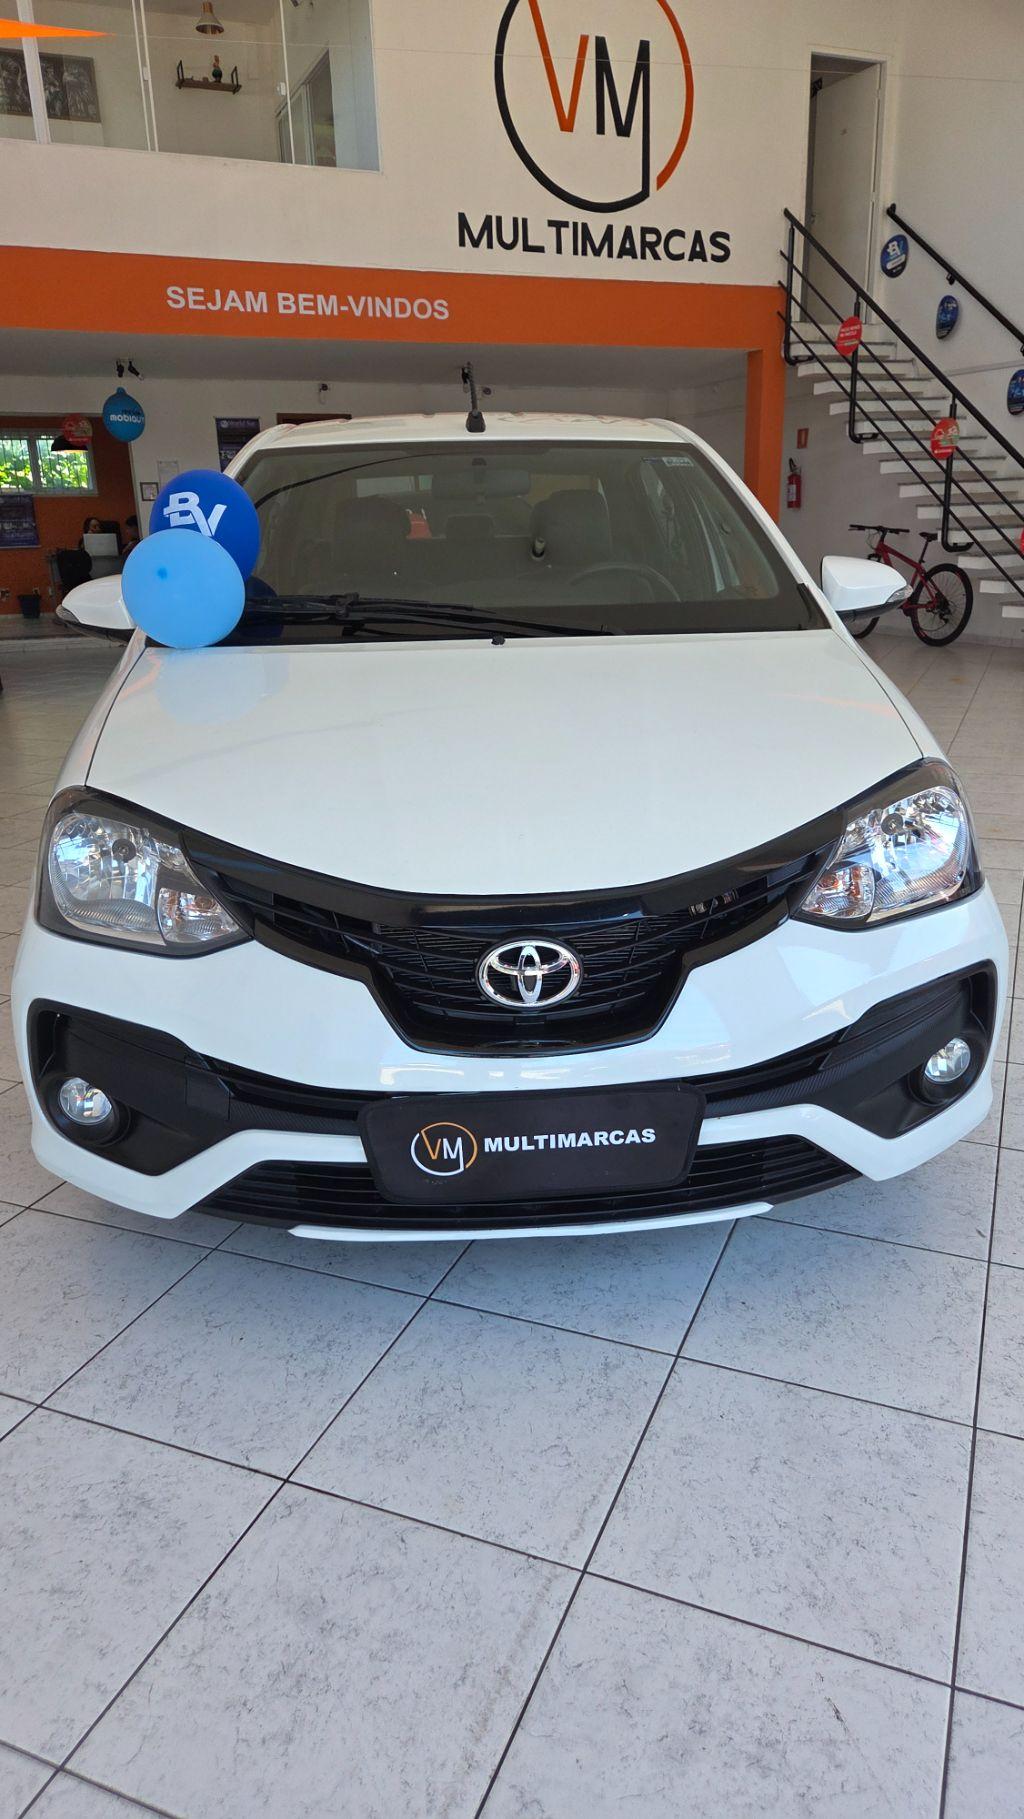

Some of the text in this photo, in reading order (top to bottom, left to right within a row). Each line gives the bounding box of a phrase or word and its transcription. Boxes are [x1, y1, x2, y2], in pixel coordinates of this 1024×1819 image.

[458, 212, 731, 263] MULTIMARCAS
[166, 286, 450, 320] SEJAM BEM-VINDOS
[163, 491, 227, 537] BV
[484, 1128, 656, 1153] MULTIMARCAS
